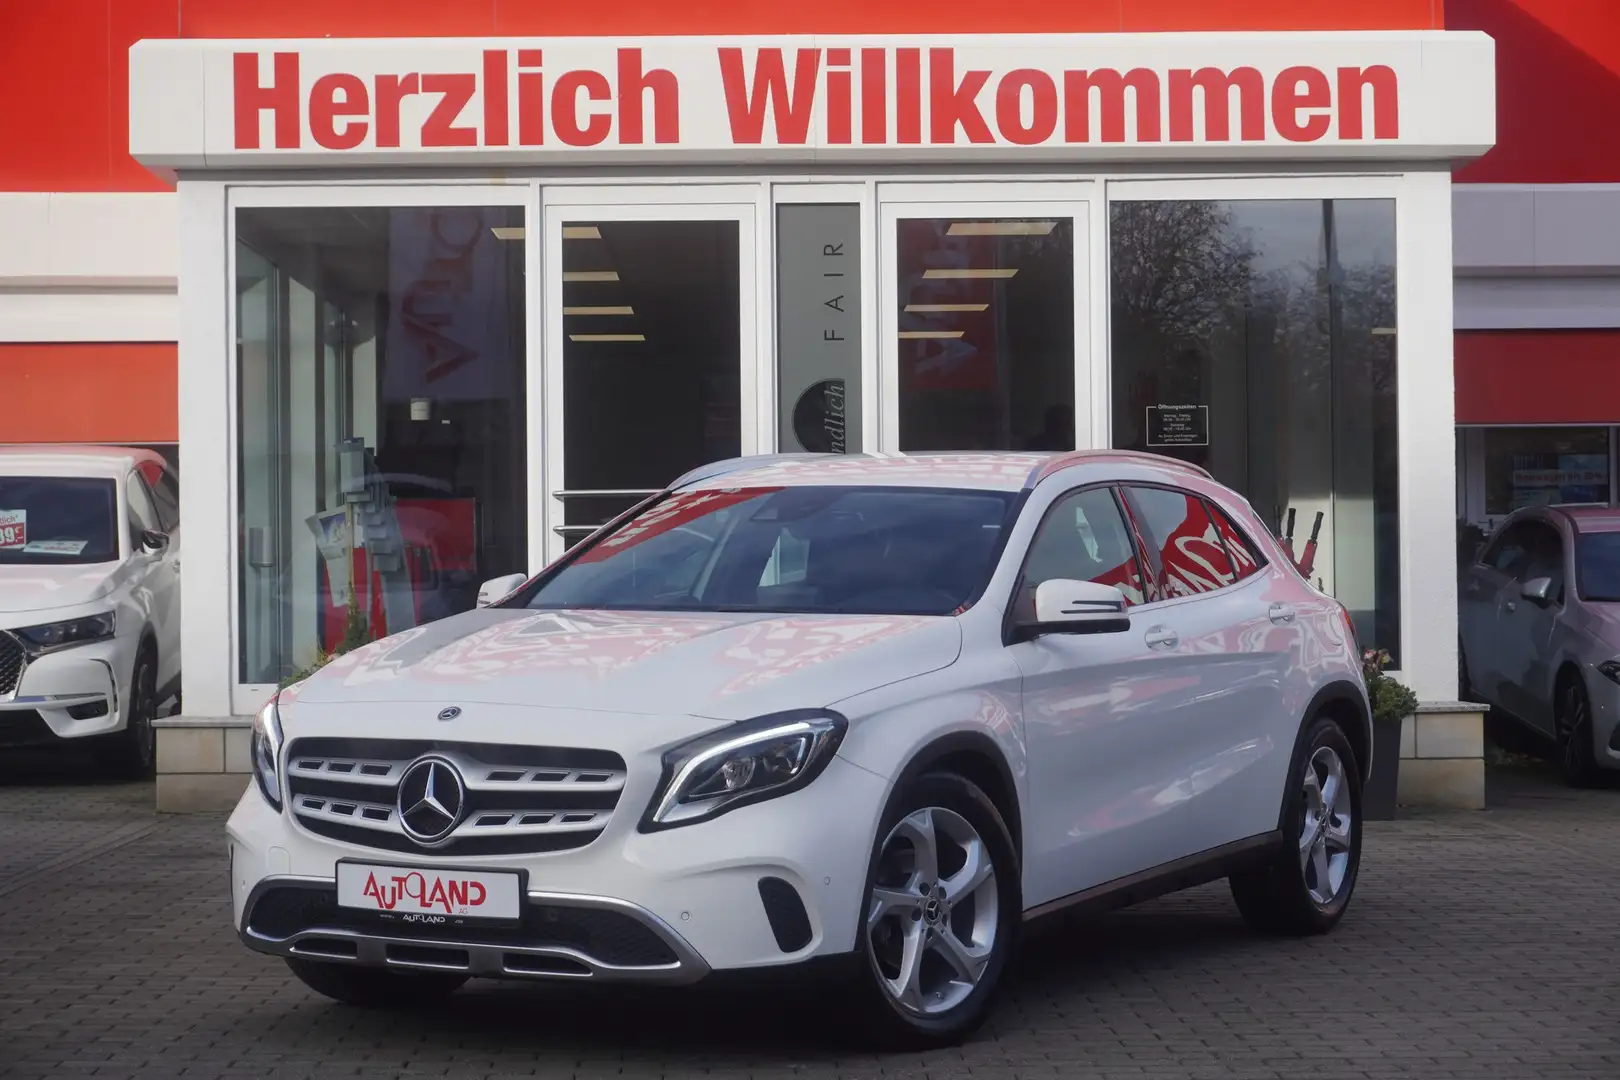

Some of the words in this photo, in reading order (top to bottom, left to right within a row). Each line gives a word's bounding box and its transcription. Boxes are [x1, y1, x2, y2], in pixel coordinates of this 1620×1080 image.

[233, 47, 679, 150] Herzlich
[717, 46, 1399, 146] Willkommen
[823, 243, 844, 340] FAIR
